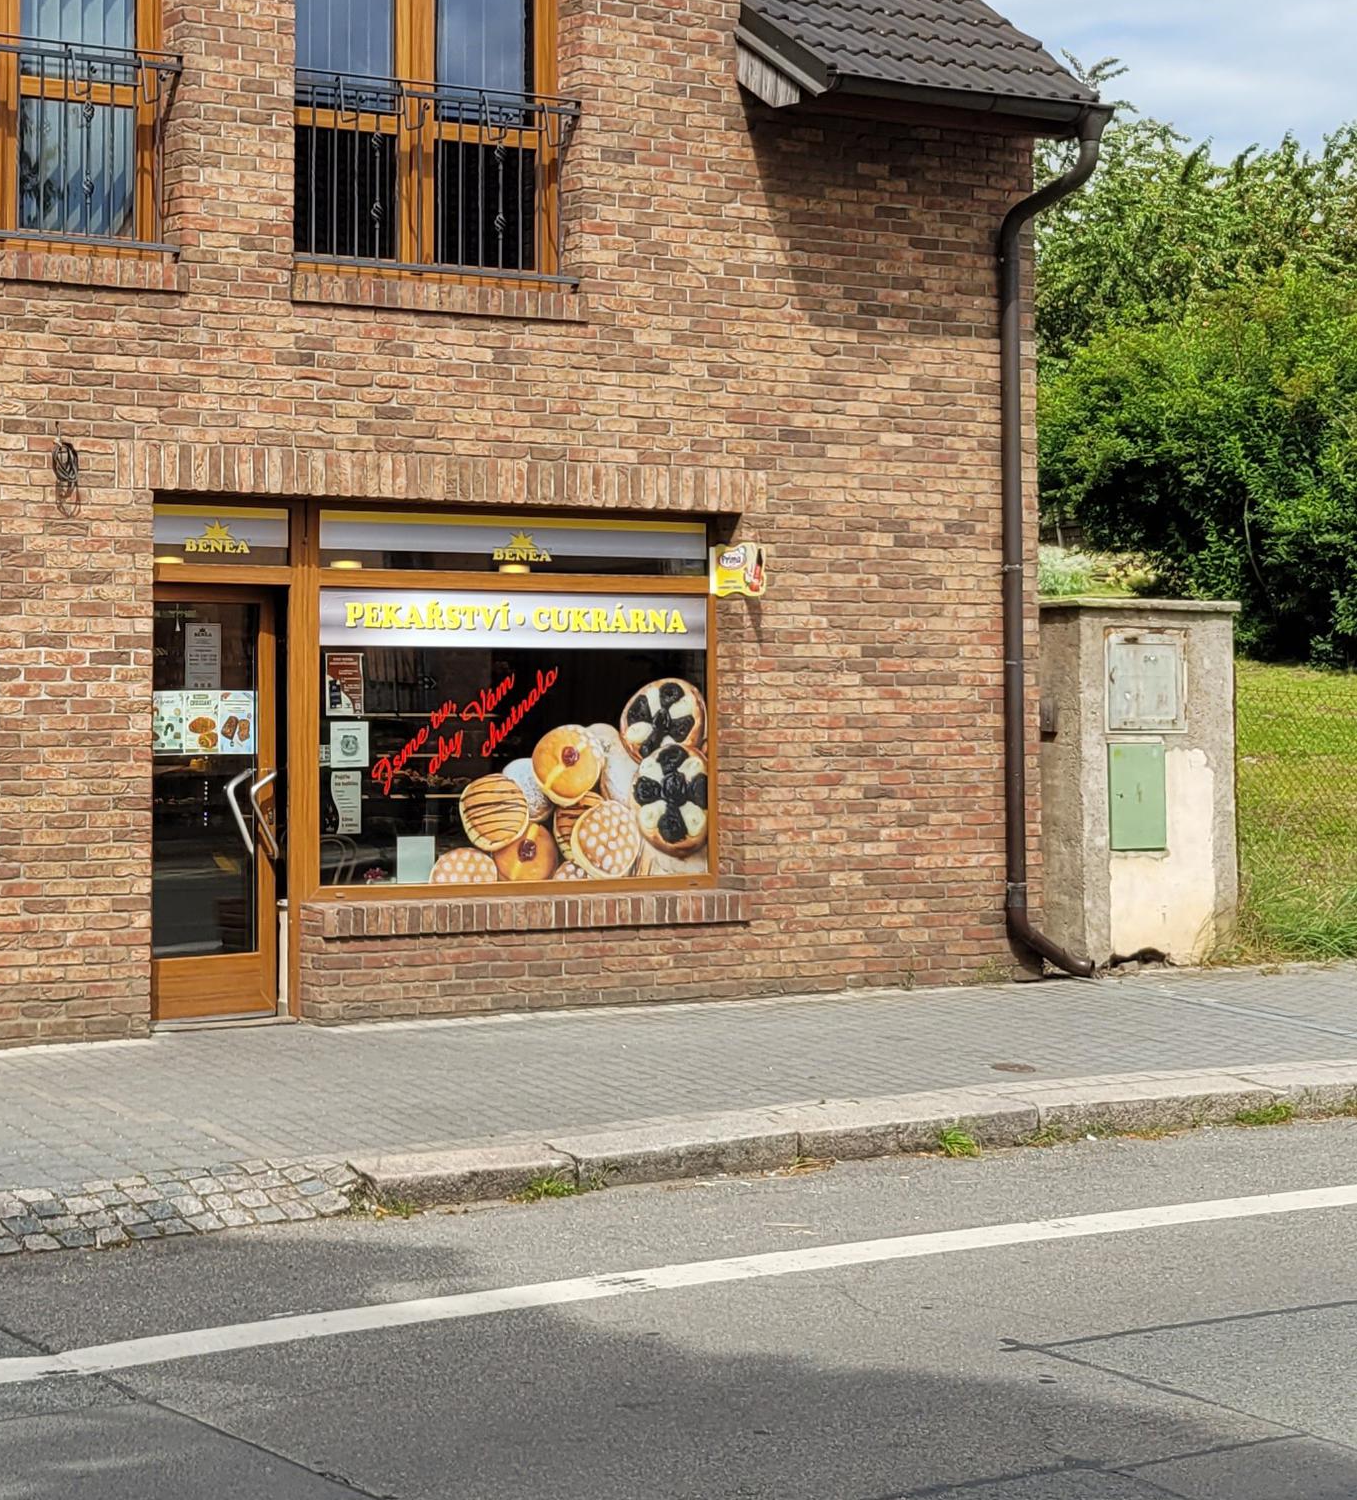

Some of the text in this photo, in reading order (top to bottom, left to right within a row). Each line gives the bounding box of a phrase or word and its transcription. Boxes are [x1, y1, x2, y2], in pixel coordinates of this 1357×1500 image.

[184, 538, 251, 554] BENEA
[492, 547, 553, 562] BENEA
[344, 601, 689, 634] PEKAŘSTVÍ CUKRÁRNA
[429, 672, 515, 775] aby Vám
[481, 665, 559, 758] chutnalo
[372, 725, 430, 796] Jsme
